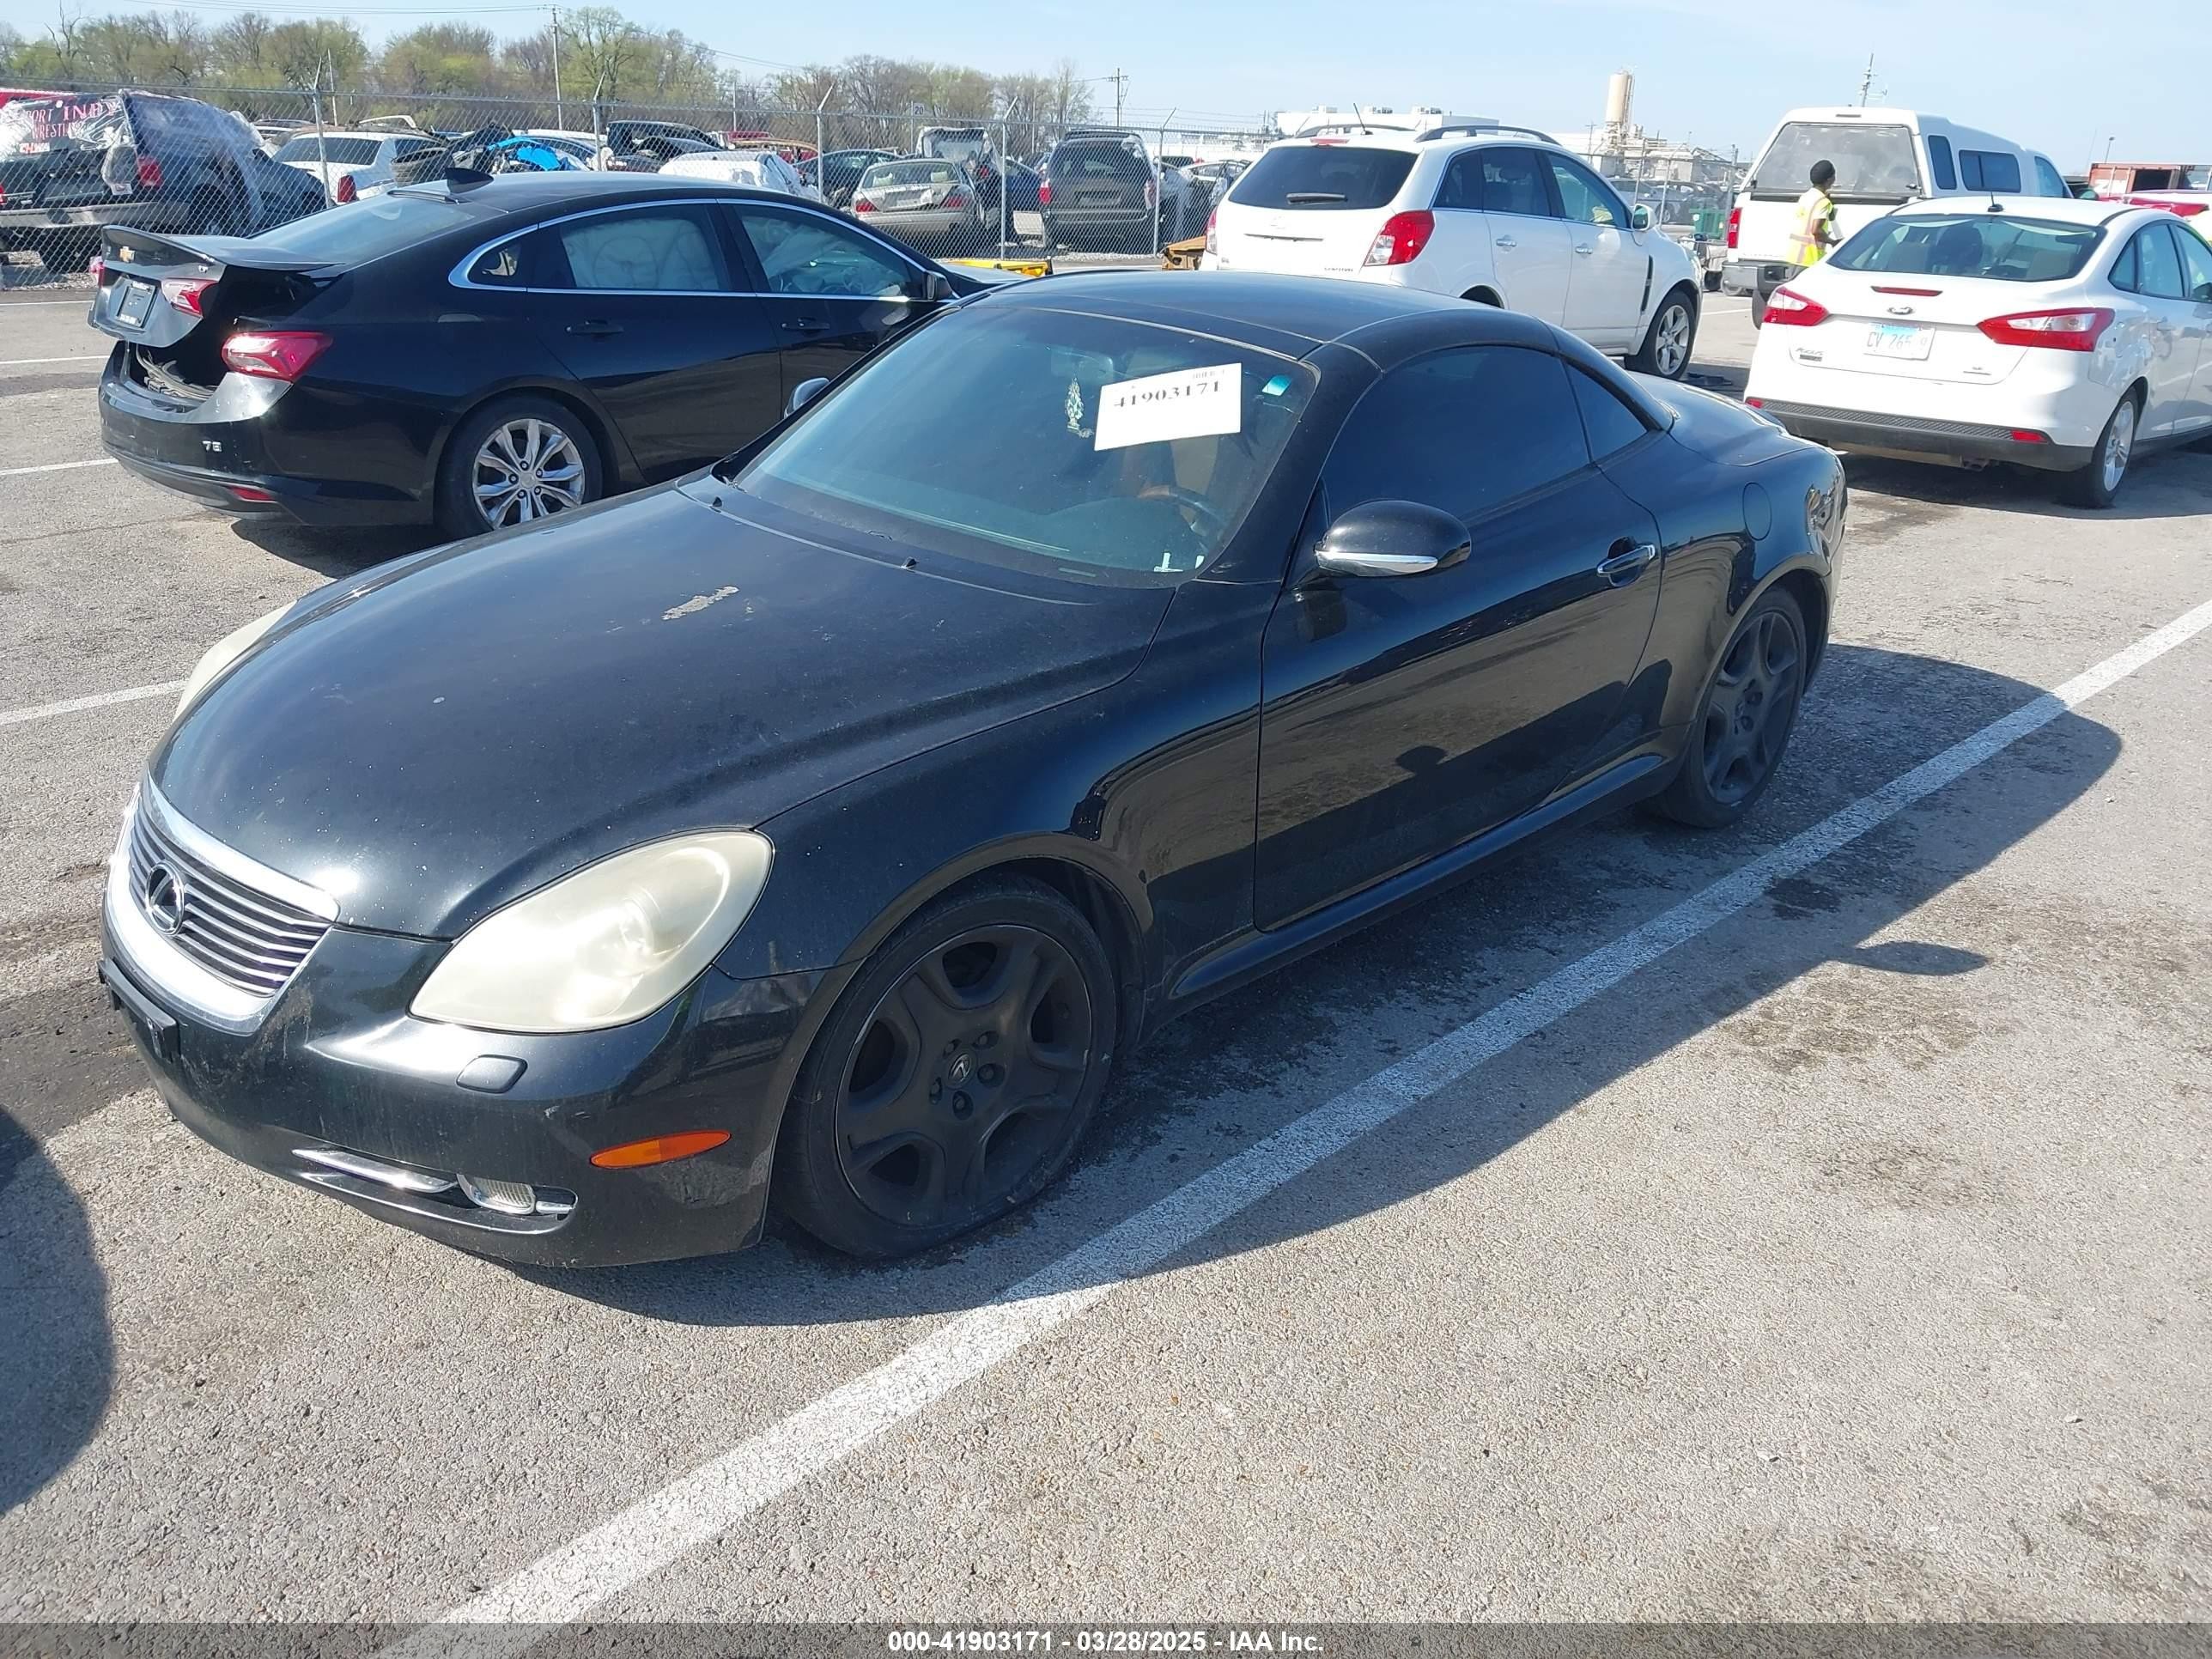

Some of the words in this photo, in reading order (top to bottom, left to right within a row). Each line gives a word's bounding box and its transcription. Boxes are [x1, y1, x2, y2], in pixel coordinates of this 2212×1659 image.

[63, 100, 118, 121] INDY
[915, 106, 924, 115] 20
[1867, 331, 1884, 348] CV
[1888, 333, 1928, 351] 2659
[1114, 380, 1219, 408] 41903171
